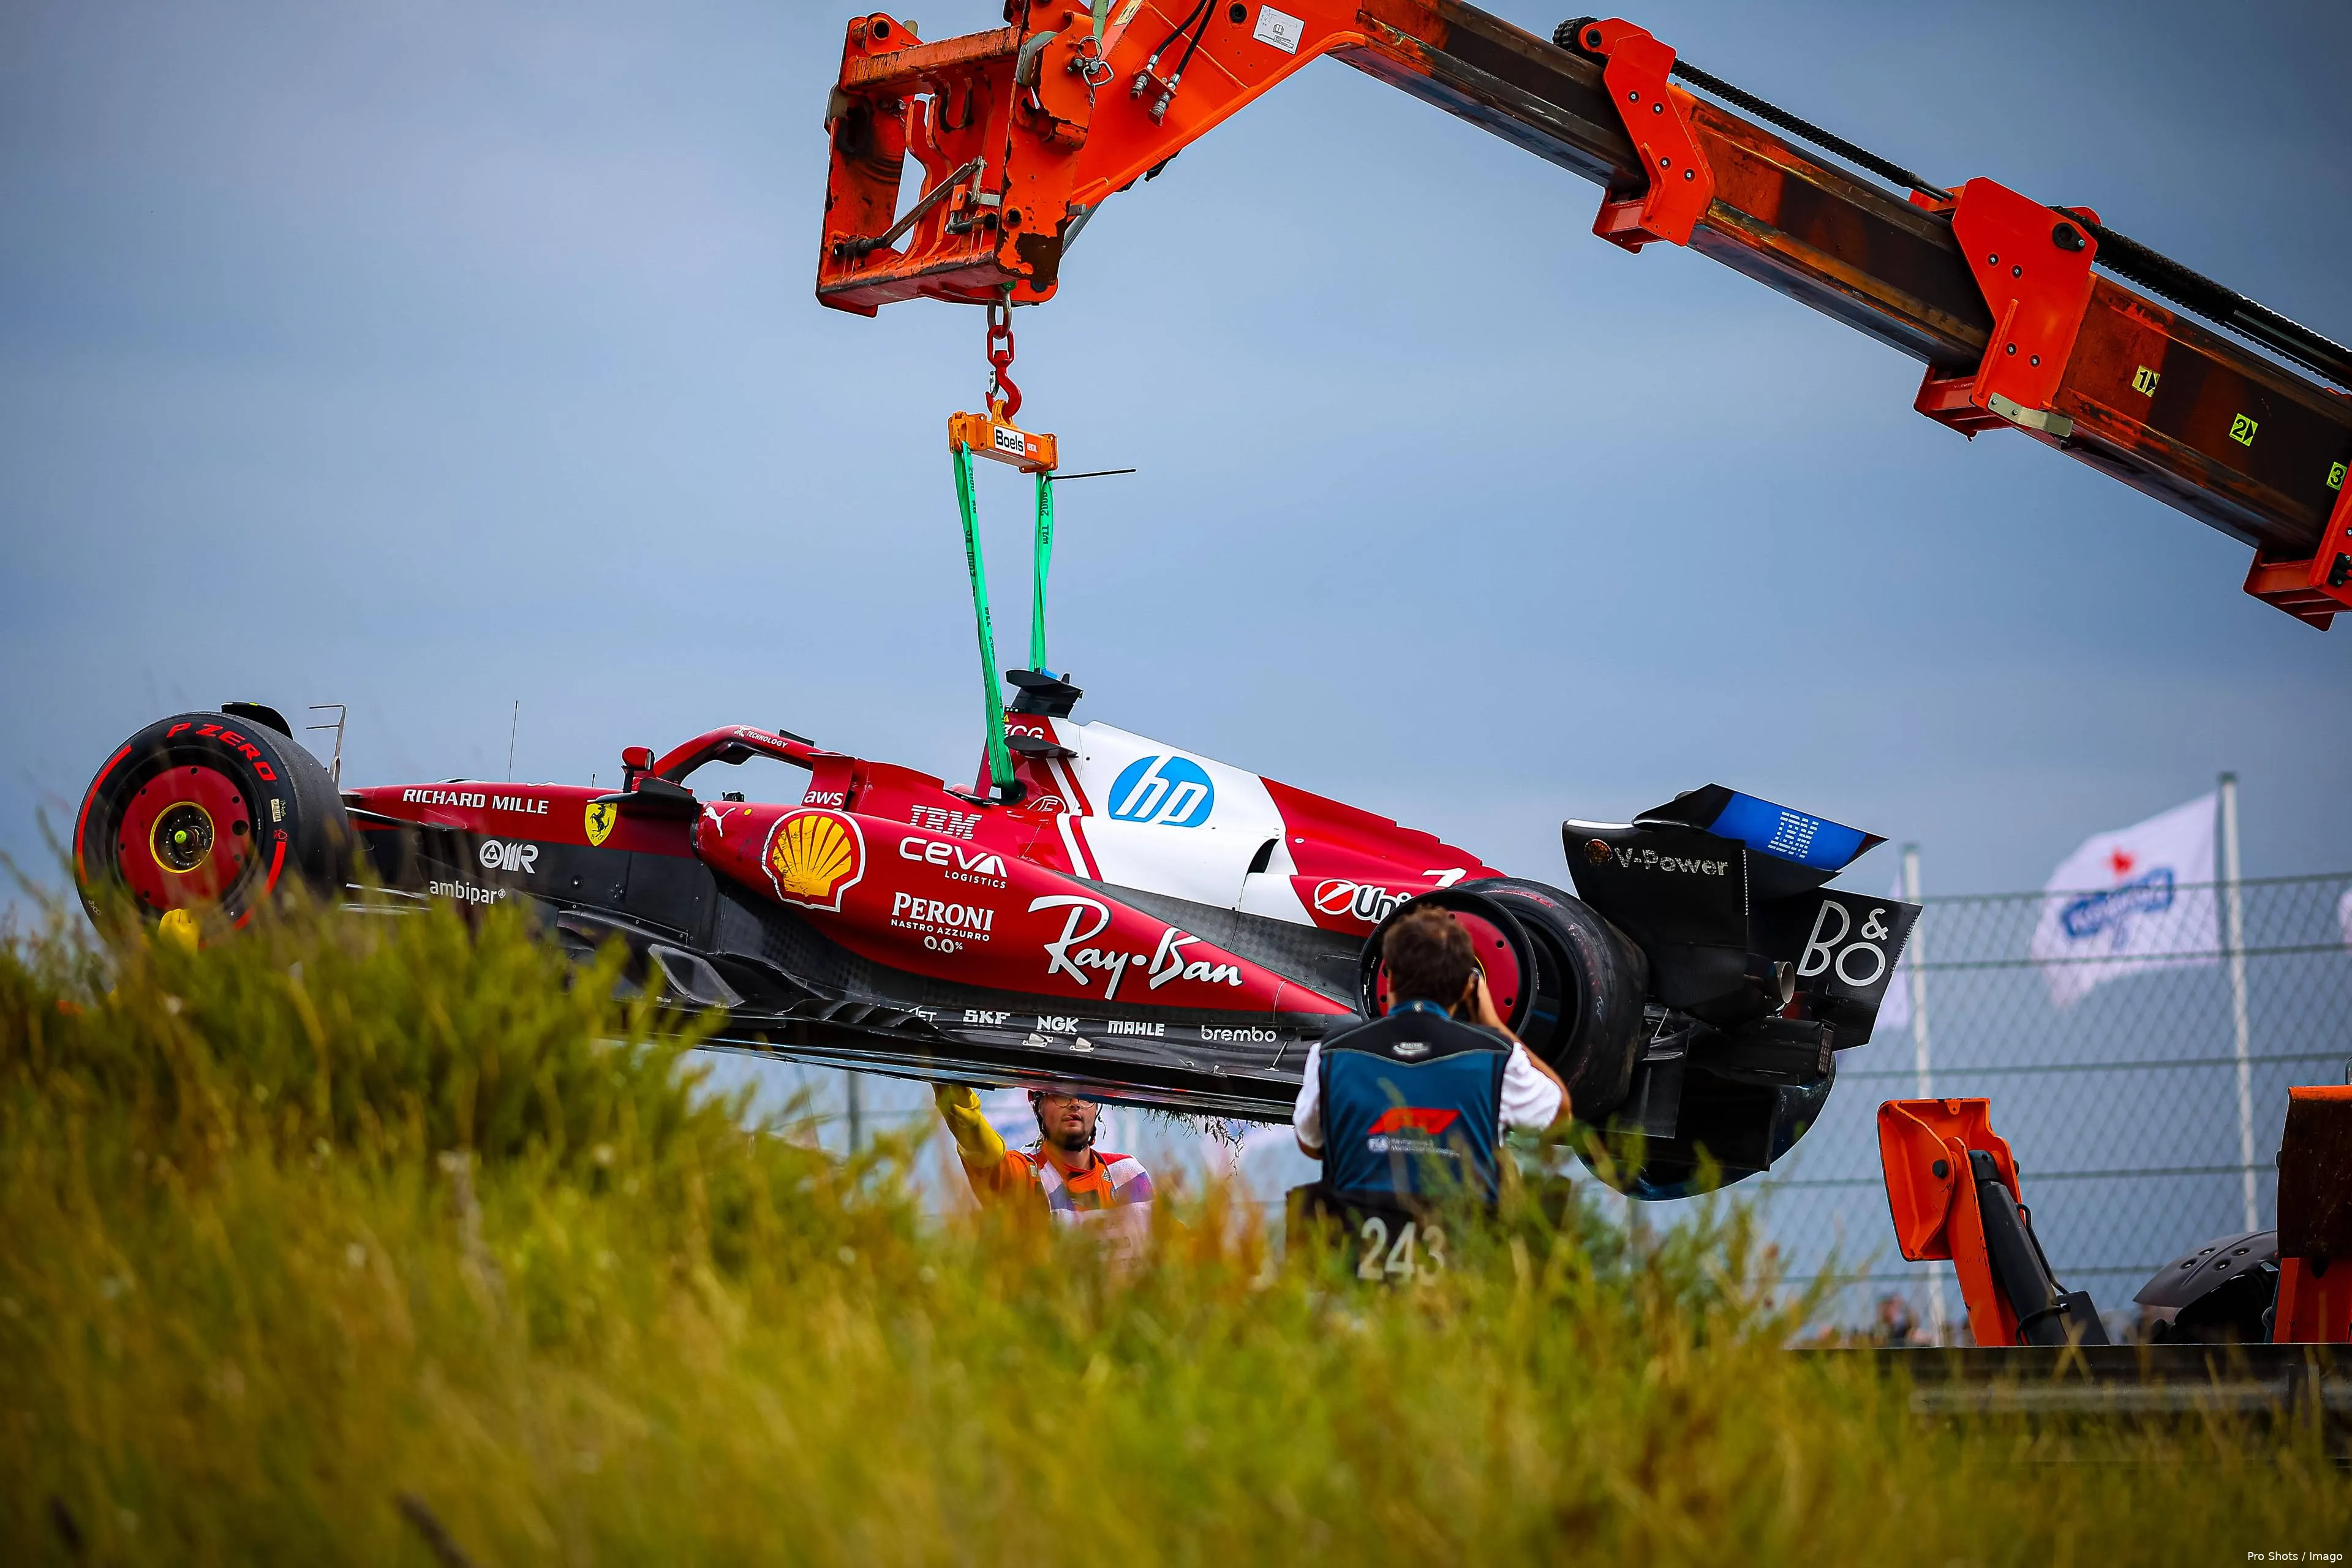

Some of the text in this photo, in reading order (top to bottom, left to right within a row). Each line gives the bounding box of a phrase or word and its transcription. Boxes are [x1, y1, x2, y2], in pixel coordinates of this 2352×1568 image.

[2136, 369, 2149, 390] 1
[2231, 418, 2247, 438] 2
[995, 429, 1023, 452] Boels
[2331, 466, 2344, 486] 3
[745, 731, 789, 748] TECHNOLOGY
[167, 722, 277, 781] P ZERO
[804, 790, 843, 806] aws
[1110, 755, 1213, 827] hp
[402, 789, 549, 815] RICHARD MILLE
[908, 804, 982, 840] IBM
[1614, 846, 1730, 876] V-Power
[944, 870, 1006, 889] LOGISTICS
[429, 880, 497, 905] ambipar
[891, 892, 995, 932] PERONI
[891, 919, 990, 941] NASTRO AZZURRO
[924, 935, 963, 954] 0.0%
[963, 1009, 1011, 1025] SKF
[1037, 1016, 1078, 1034] NGK
[1107, 1020, 1165, 1036] MAHLE
[1200, 1025, 1276, 1042] brembo
[1357, 1216, 1446, 1281] 243
